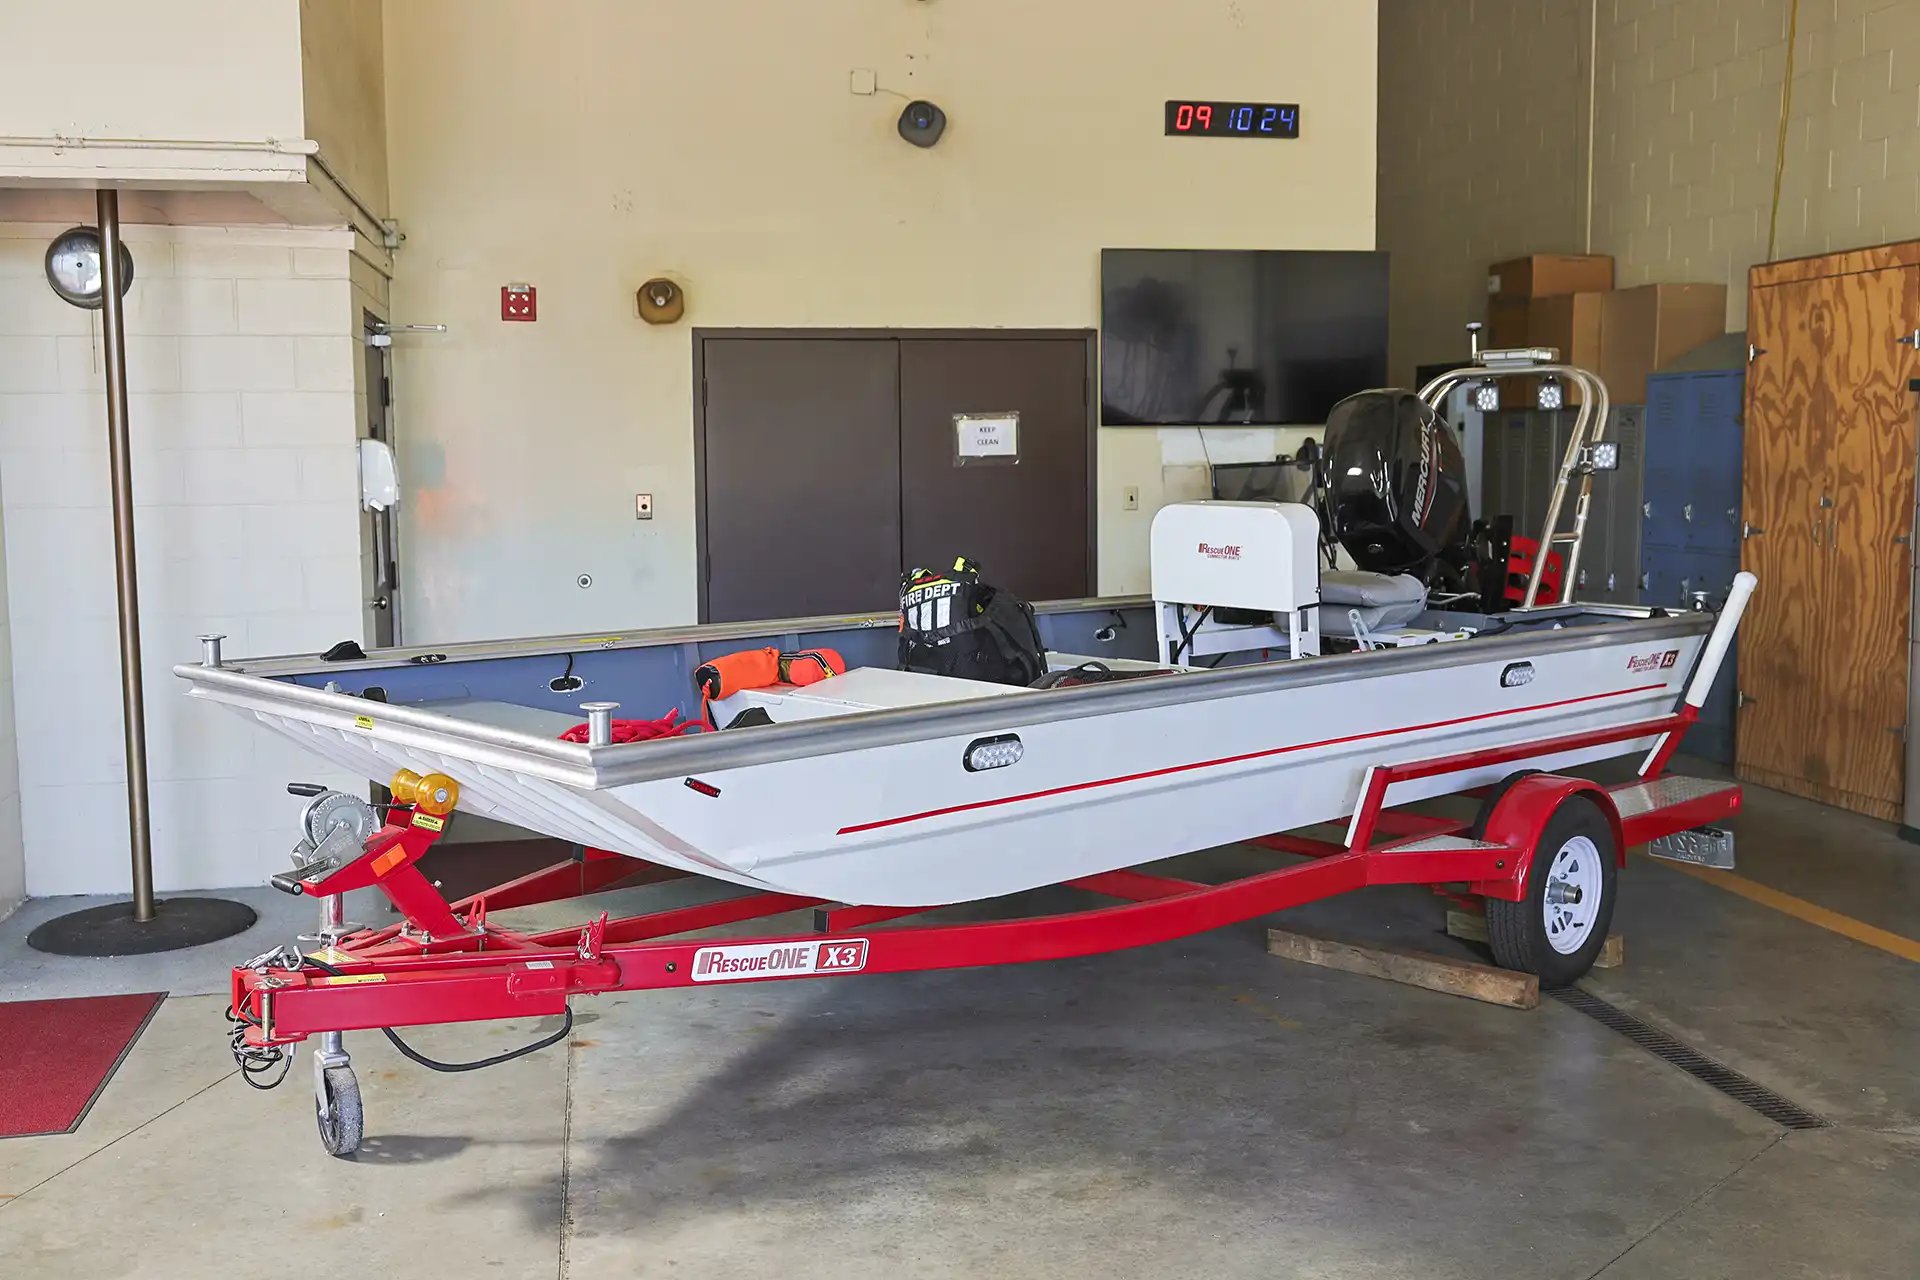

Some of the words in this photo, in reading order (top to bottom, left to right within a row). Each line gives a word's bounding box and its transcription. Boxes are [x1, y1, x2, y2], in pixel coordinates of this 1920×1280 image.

[1176, 105, 1212, 131] 09
[1228, 107, 1253, 131] 10
[1260, 108, 1295, 132] 24
[1411, 416, 1432, 527] MERCURY
[901, 589, 922, 610] FIRE
[924, 582, 961, 600] DEPT
[822, 946, 857, 968] X3
